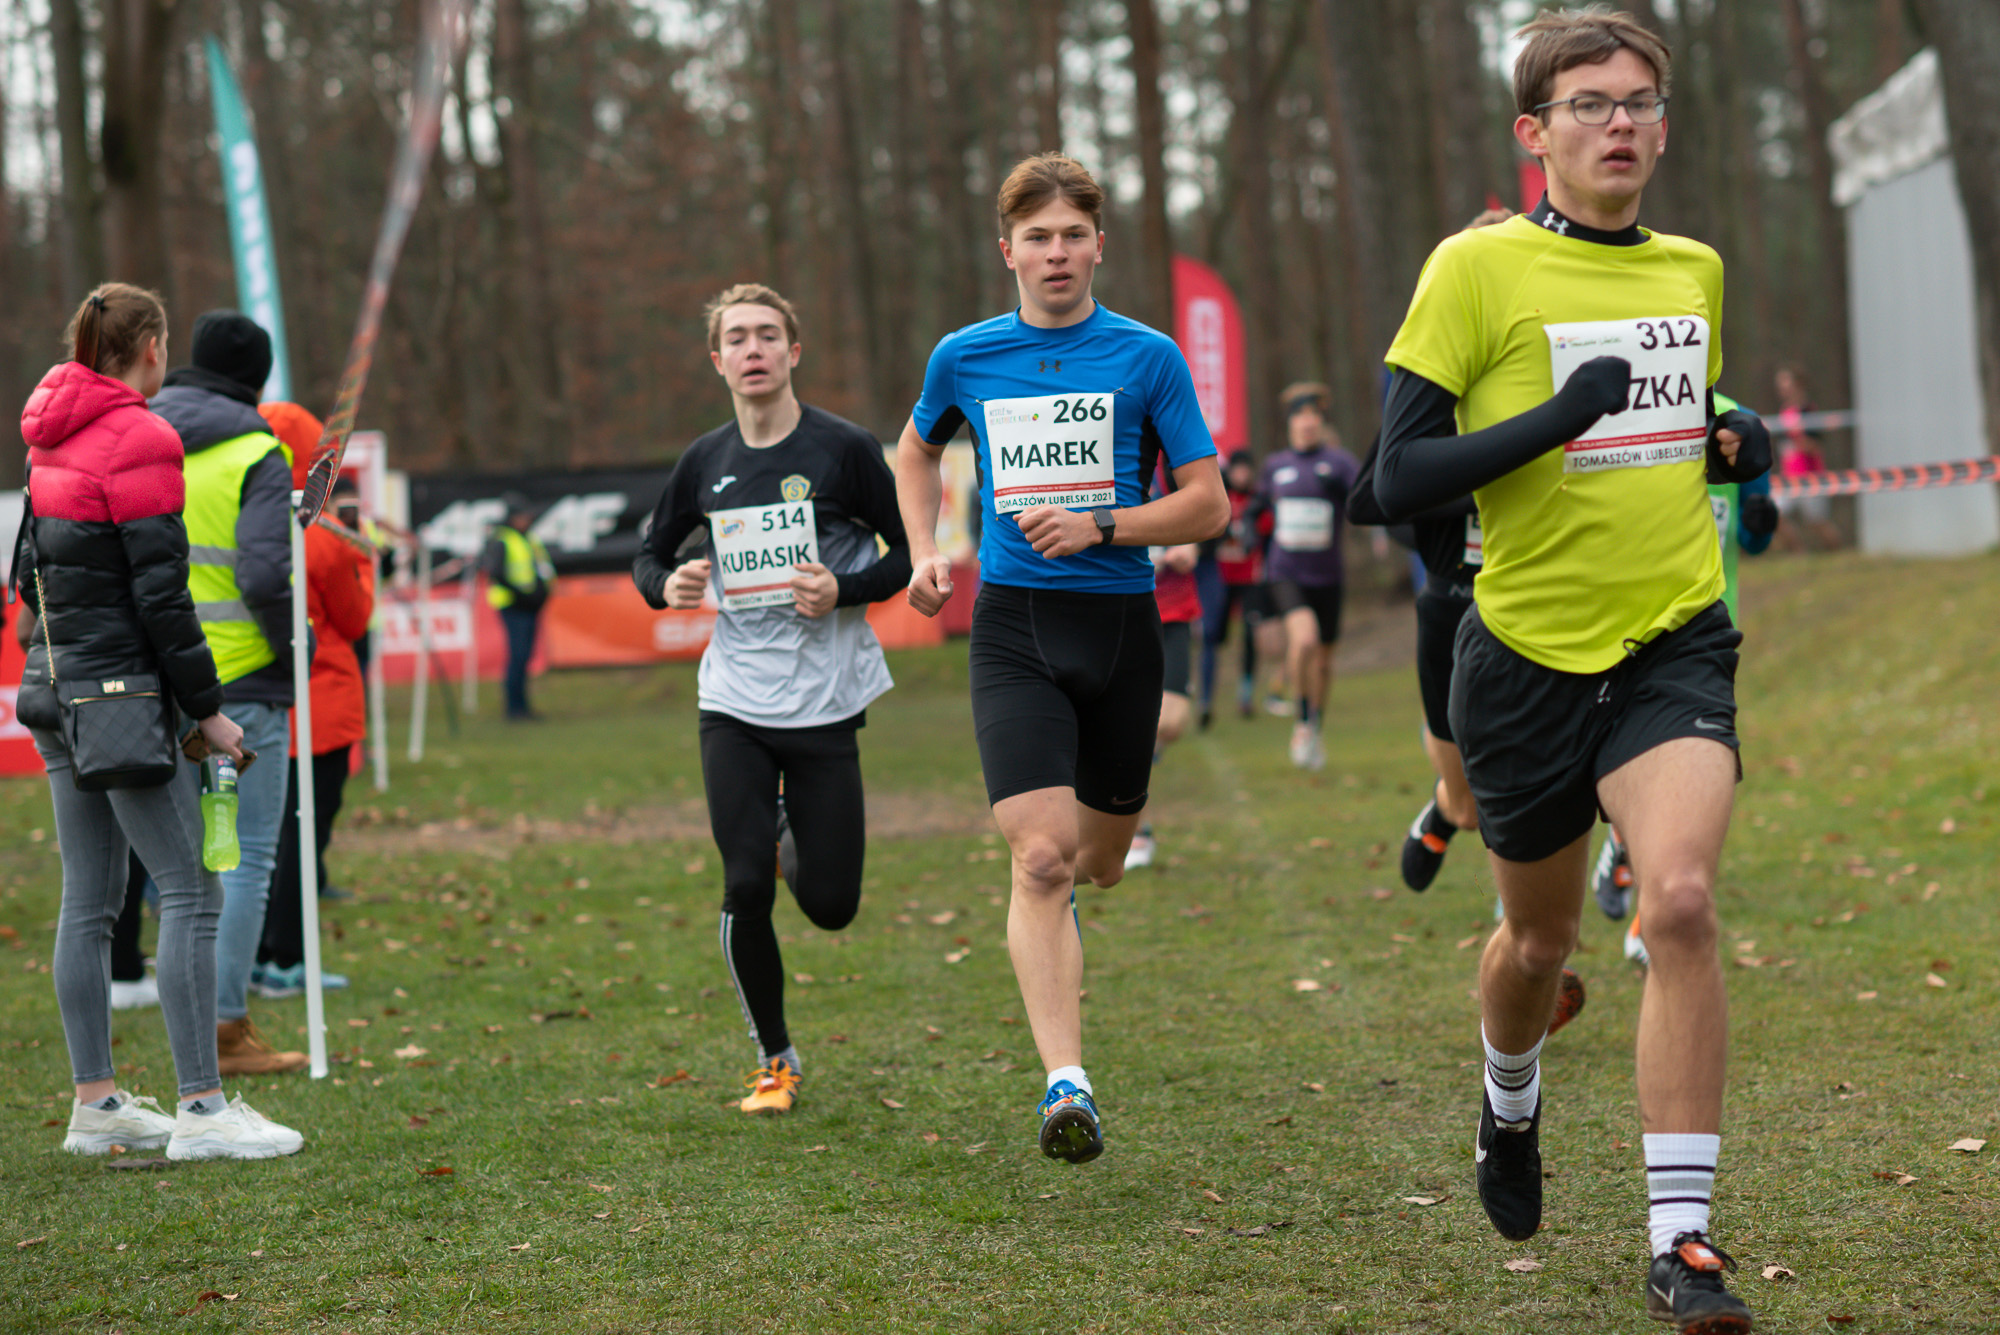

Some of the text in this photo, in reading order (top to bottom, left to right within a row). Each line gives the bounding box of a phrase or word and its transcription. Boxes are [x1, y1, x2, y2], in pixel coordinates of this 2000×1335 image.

[1636, 320, 1702, 350] 312
[1630, 372, 1697, 410] ZKA
[1053, 398, 1107, 423] 266
[1001, 440, 1100, 470] MAREK
[1573, 449, 1642, 468] TOMASZÓW
[1645, 447, 1687, 461] LUBELSKI
[999, 492, 1112, 509] TOMASZÓW LUBELSKI 2021
[532, 491, 631, 552] 4F
[762, 507, 807, 532] 514
[720, 543, 813, 574] KUBASIK
[764, 591, 794, 602] LUBELSK
